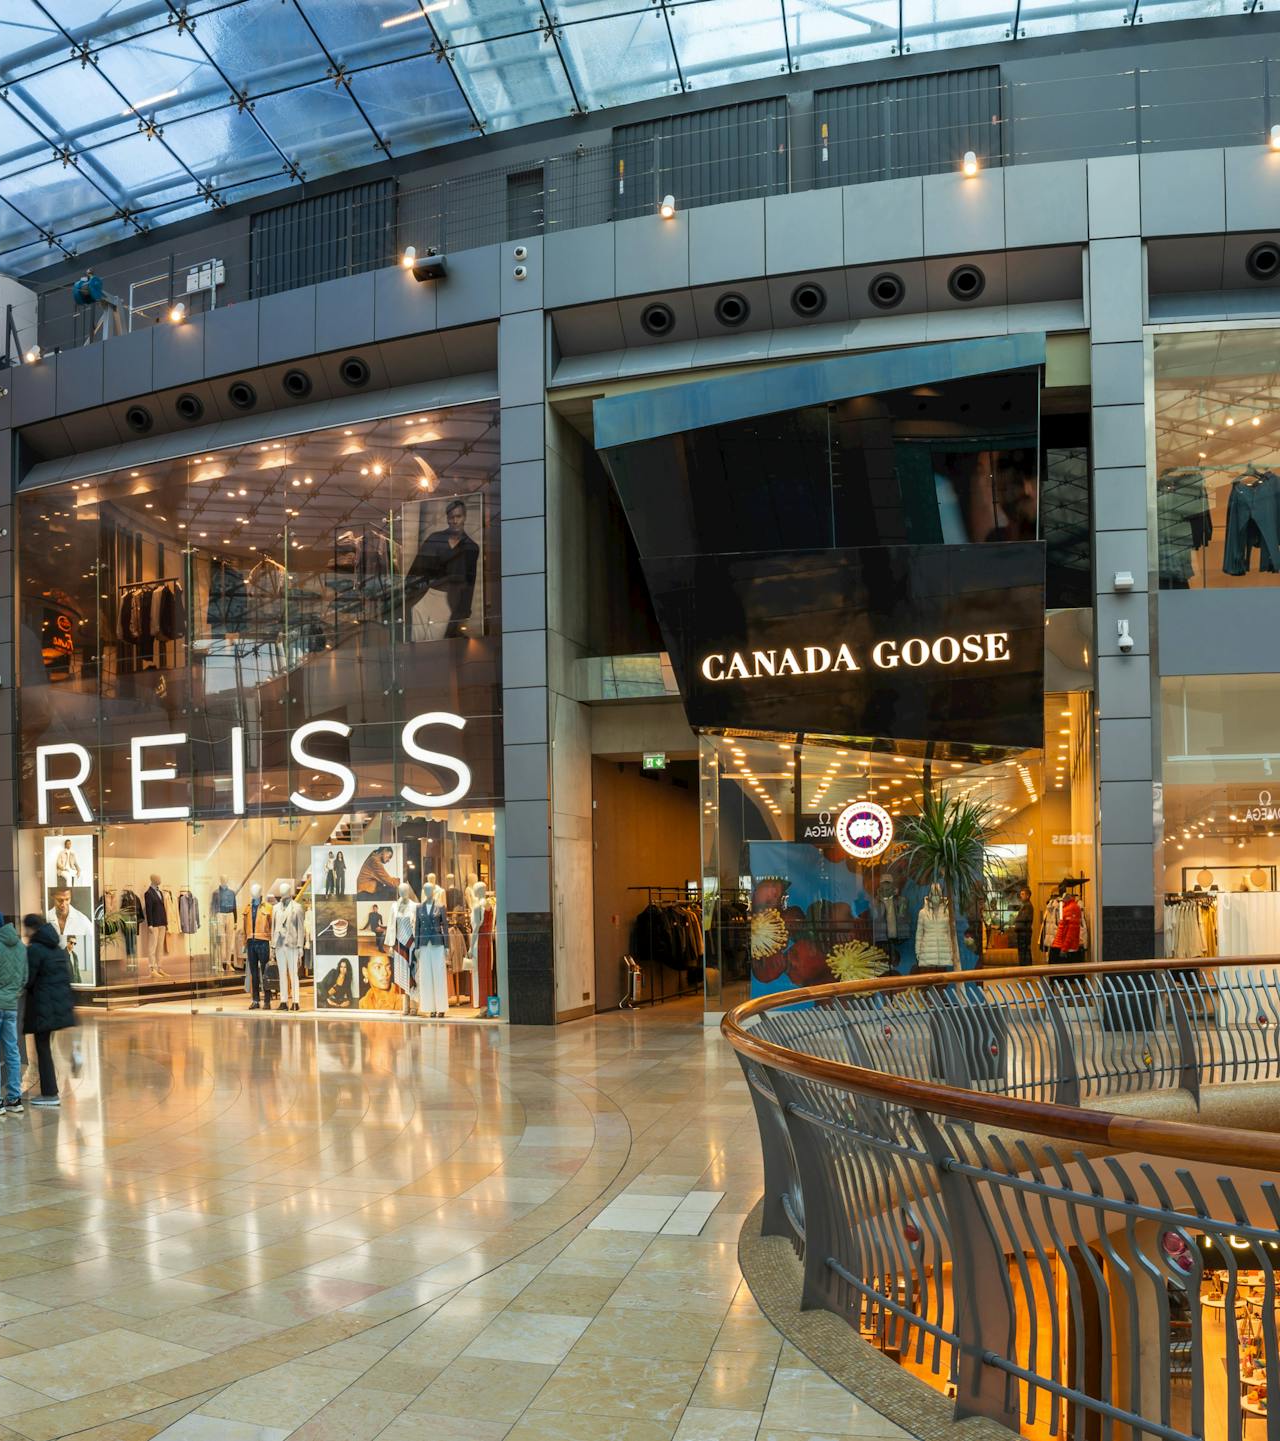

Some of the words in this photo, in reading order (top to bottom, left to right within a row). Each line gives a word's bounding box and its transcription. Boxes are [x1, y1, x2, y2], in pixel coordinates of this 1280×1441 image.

[701, 643, 860, 681] CANADA
[872, 632, 1011, 669] GOOSE
[36, 711, 473, 825] REISS
